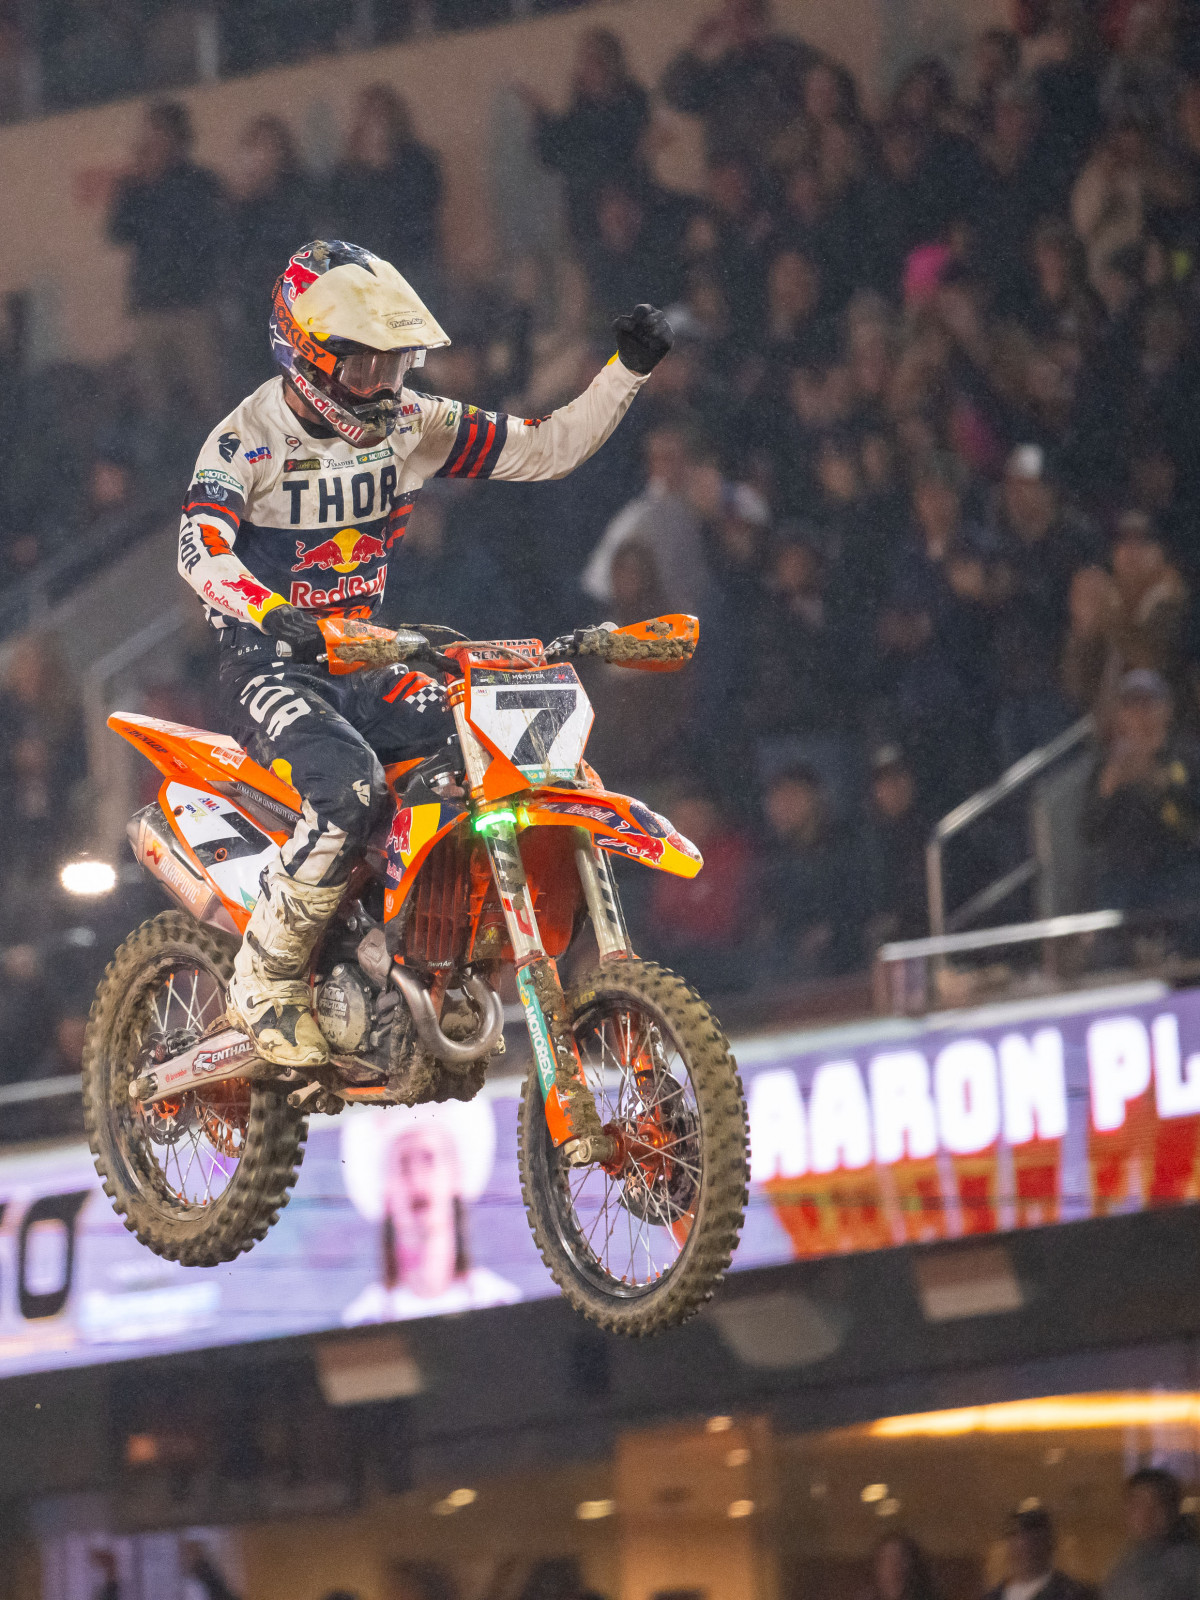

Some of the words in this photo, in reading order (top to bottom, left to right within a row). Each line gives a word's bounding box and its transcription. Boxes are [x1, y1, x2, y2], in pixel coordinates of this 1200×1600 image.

[277, 306, 326, 363] OAKLEY
[294, 374, 332, 413] Red
[282, 464, 398, 524] THOR
[179, 521, 202, 575] THOR
[290, 576, 347, 608] Red
[347, 564, 387, 598] Bull
[237, 644, 262, 656] U.S.A.
[471, 648, 541, 660] RENAL
[128, 730, 168, 754] DUNLOP
[496, 689, 577, 767] 7
[525, 1005, 554, 1080] MOTOREX
[749, 1025, 1069, 1183] AARON
